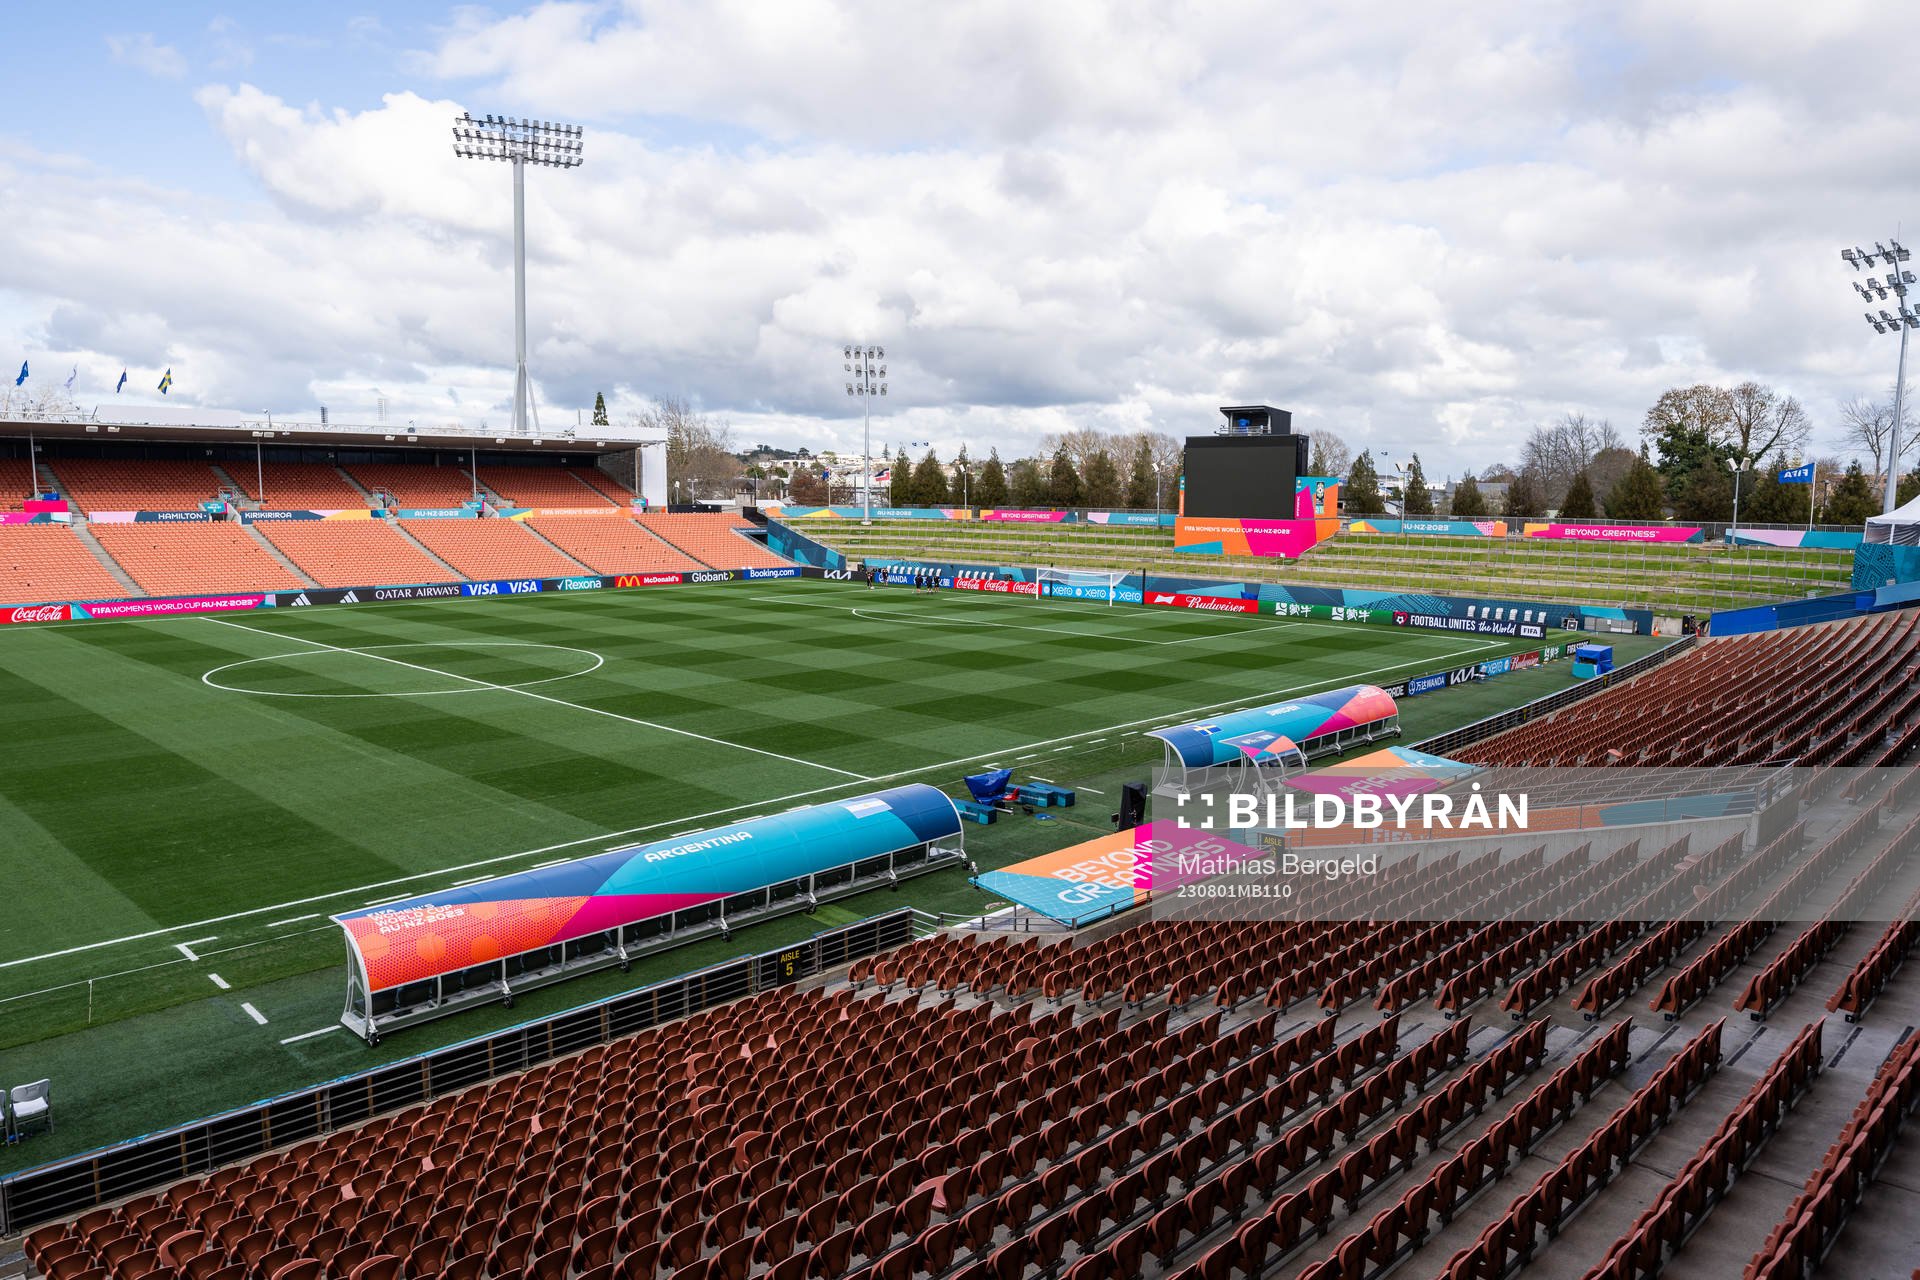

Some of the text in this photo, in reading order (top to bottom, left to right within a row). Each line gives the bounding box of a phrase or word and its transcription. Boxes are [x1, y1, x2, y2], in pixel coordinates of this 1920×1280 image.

[158, 512, 203, 520] HAMILTON
[1564, 528, 1656, 538] BEYOND GREATNESS
[643, 575, 680, 584] McDonald's
[691, 571, 729, 583] Globant
[749, 568, 795, 579] Booking.com
[468, 583, 499, 596] VISA
[508, 581, 538, 594] VISA
[565, 579, 602, 591] Rexona
[1052, 586, 1073, 596] xero
[375, 586, 460, 600] QATAR AIRWAYS
[1085, 589, 1107, 599] xero
[1118, 591, 1142, 601] xero
[92, 607, 111, 615] FIFA
[111, 604, 152, 614] WOMEN'S
[153, 602, 183, 612] WORLD
[184, 601, 201, 610] CUP
[1185, 595, 1246, 613] Budweiser
[11, 605, 64, 623] Coca-Cola
[1410, 615, 1517, 636] FOOTBALL UNITES the World
[1523, 627, 1539, 635] FIFA
[643, 830, 753, 863] ARGENTINA
[1264, 836, 1282, 847] AISLE
[1052, 839, 1172, 885] BEYOND
[1057, 838, 1225, 905] GREATNESS
[375, 904, 453, 927] WORLD CUP
[780, 950, 800, 963] AISLE
[785, 962, 794, 977] 5
